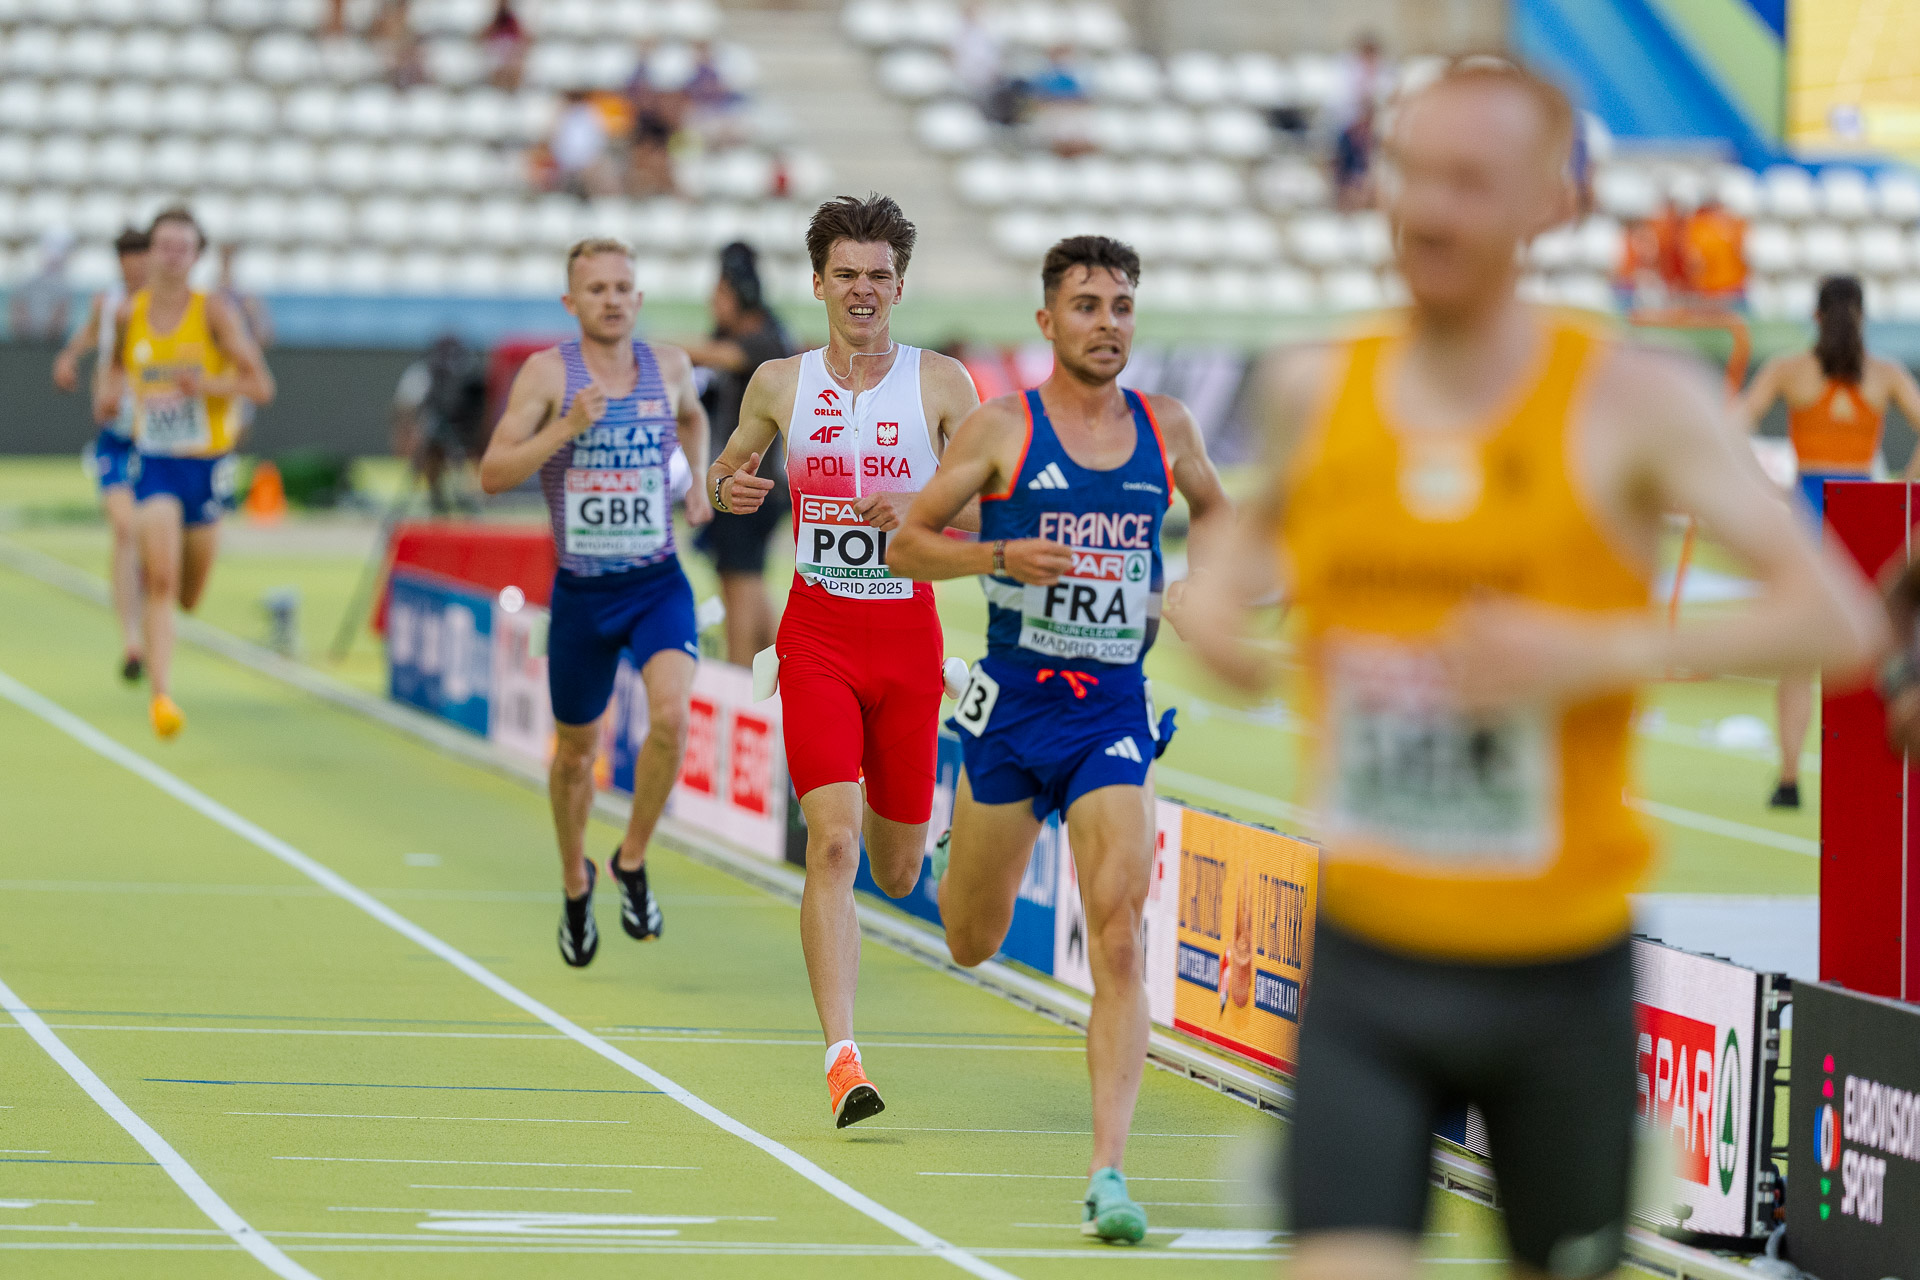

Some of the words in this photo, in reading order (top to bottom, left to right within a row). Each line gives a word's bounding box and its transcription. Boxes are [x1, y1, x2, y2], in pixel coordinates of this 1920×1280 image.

[814, 408, 843, 417] ORLEN
[573, 424, 665, 447] GREAT
[809, 425, 845, 444] 4F
[572, 448, 664, 468] BRITAIN
[580, 497, 652, 525] GBR
[803, 500, 864, 523] SPA
[1039, 511, 1152, 549] FRANCE
[824, 566, 847, 577] RUN
[1070, 552, 1122, 579] PAR
[808, 576, 864, 594] ADRID
[867, 582, 903, 594] 2025
[1043, 582, 1127, 624] FRA
[1031, 631, 1097, 656] MADRID
[1099, 642, 1135, 657] 2025
[958, 677, 987, 722] 13
[1256, 974, 1299, 1018] SWITZERLAND
[1636, 1031, 1716, 1161] SPAR
[1841, 1148, 1887, 1225] SPORT
